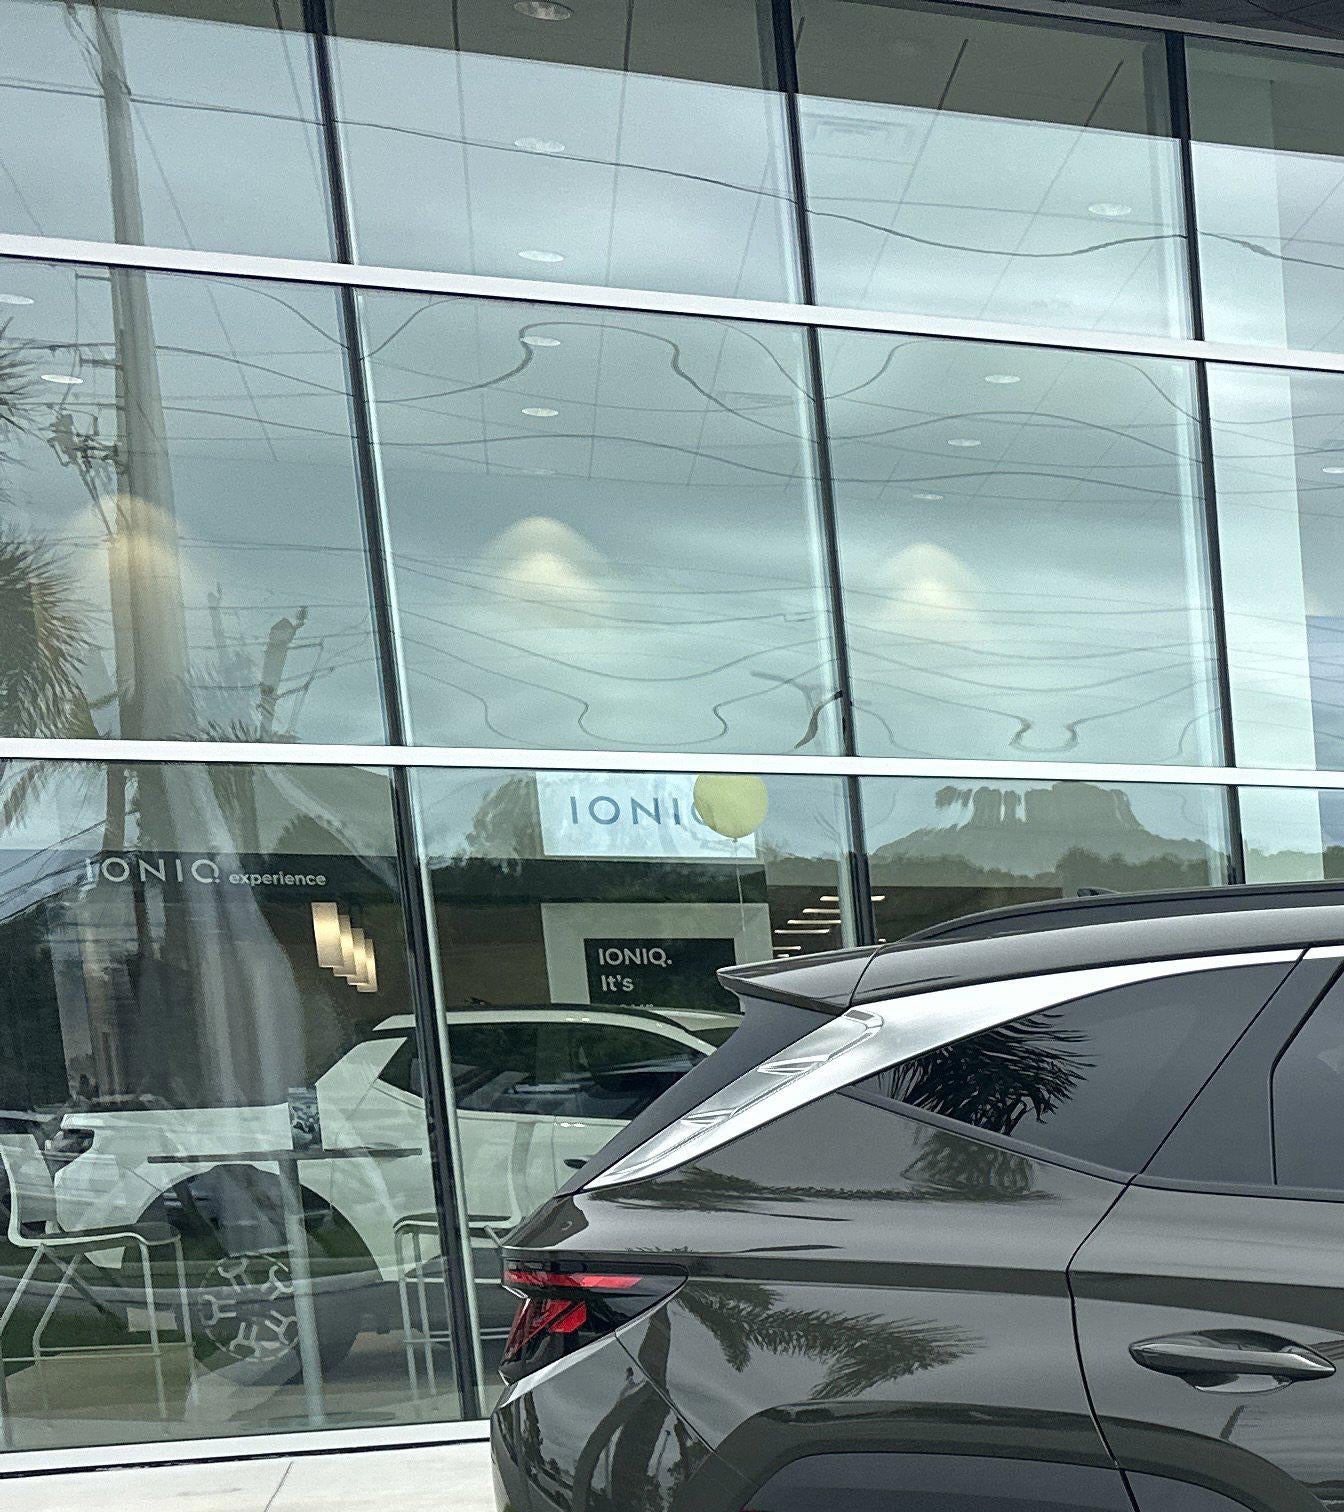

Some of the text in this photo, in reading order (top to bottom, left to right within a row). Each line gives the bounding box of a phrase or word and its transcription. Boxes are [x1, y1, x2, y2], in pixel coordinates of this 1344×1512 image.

[569, 795, 703, 825] IONI
[84, 857, 327, 886] IONIQ experience
[598, 947, 673, 967] IONIQ.
[601, 974, 634, 992] It's
